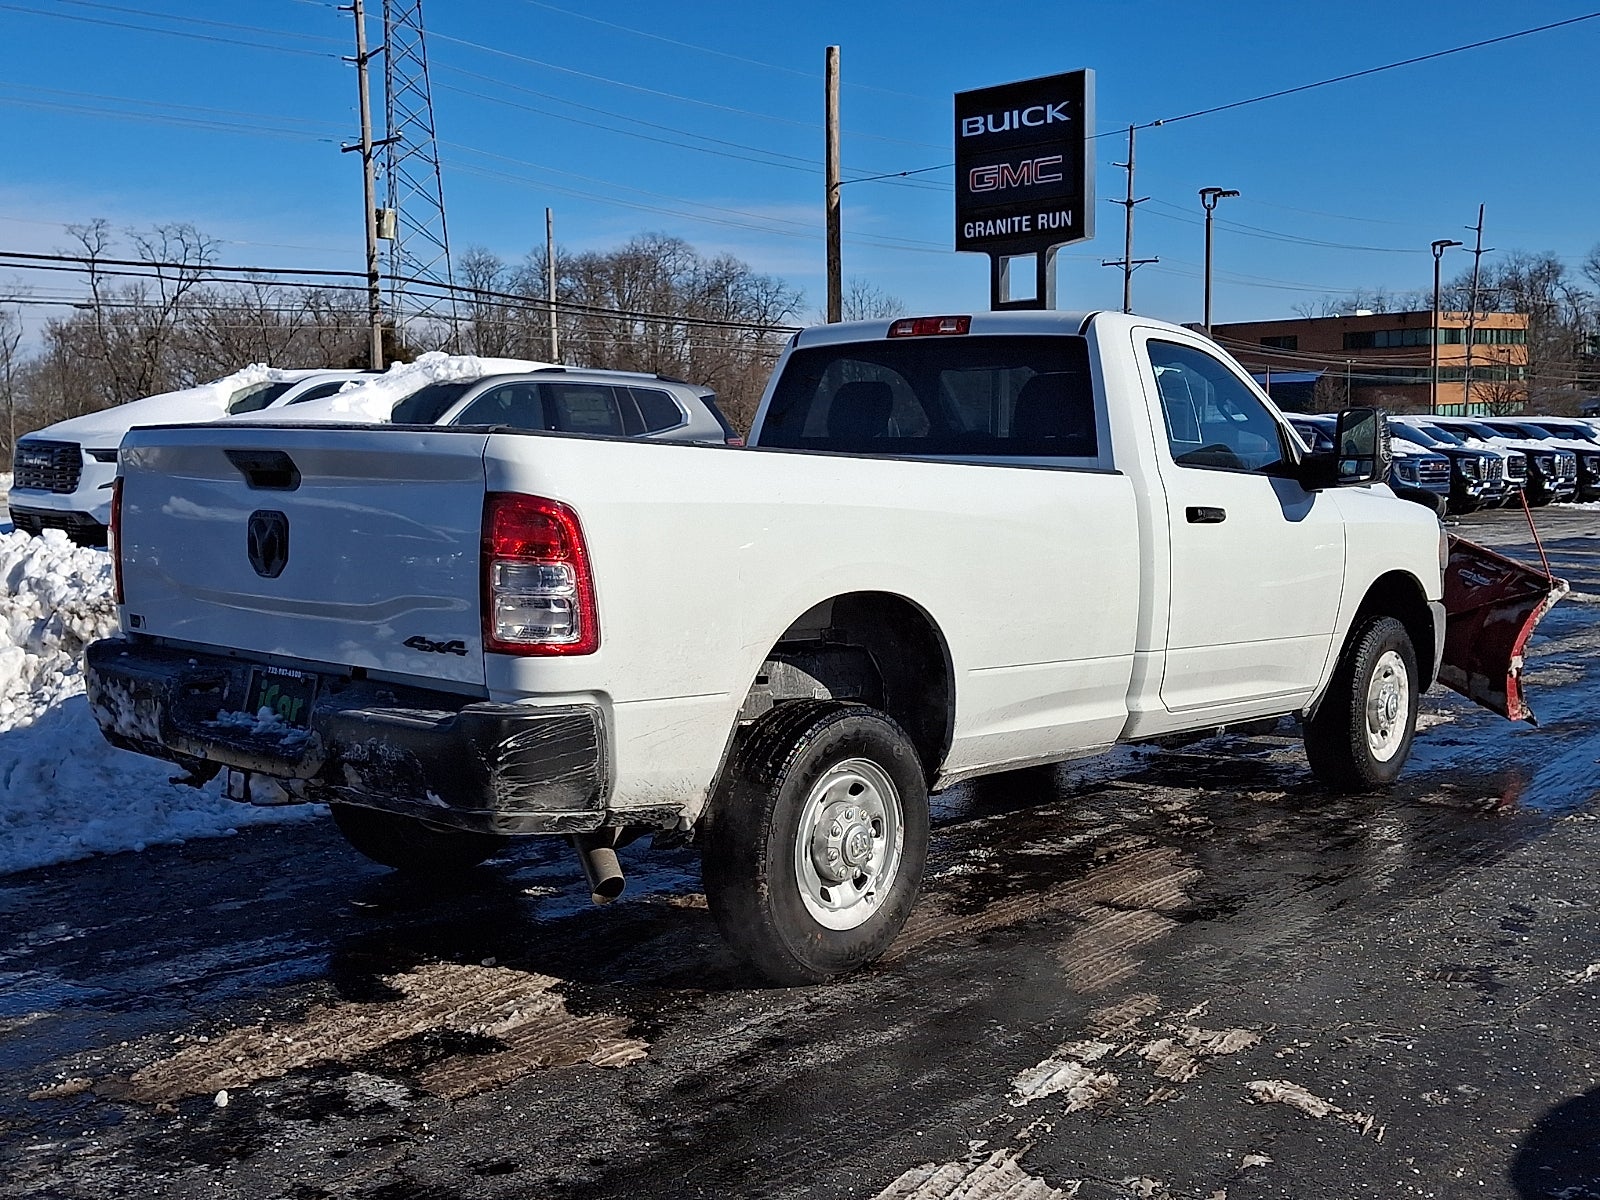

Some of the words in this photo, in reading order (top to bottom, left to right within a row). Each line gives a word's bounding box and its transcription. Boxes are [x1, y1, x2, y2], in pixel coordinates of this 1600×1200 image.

[962, 100, 1071, 137] BUICK
[969, 154, 1063, 193] GMC
[964, 216, 1031, 239] GRANITE
[1038, 210, 1072, 229] RUN
